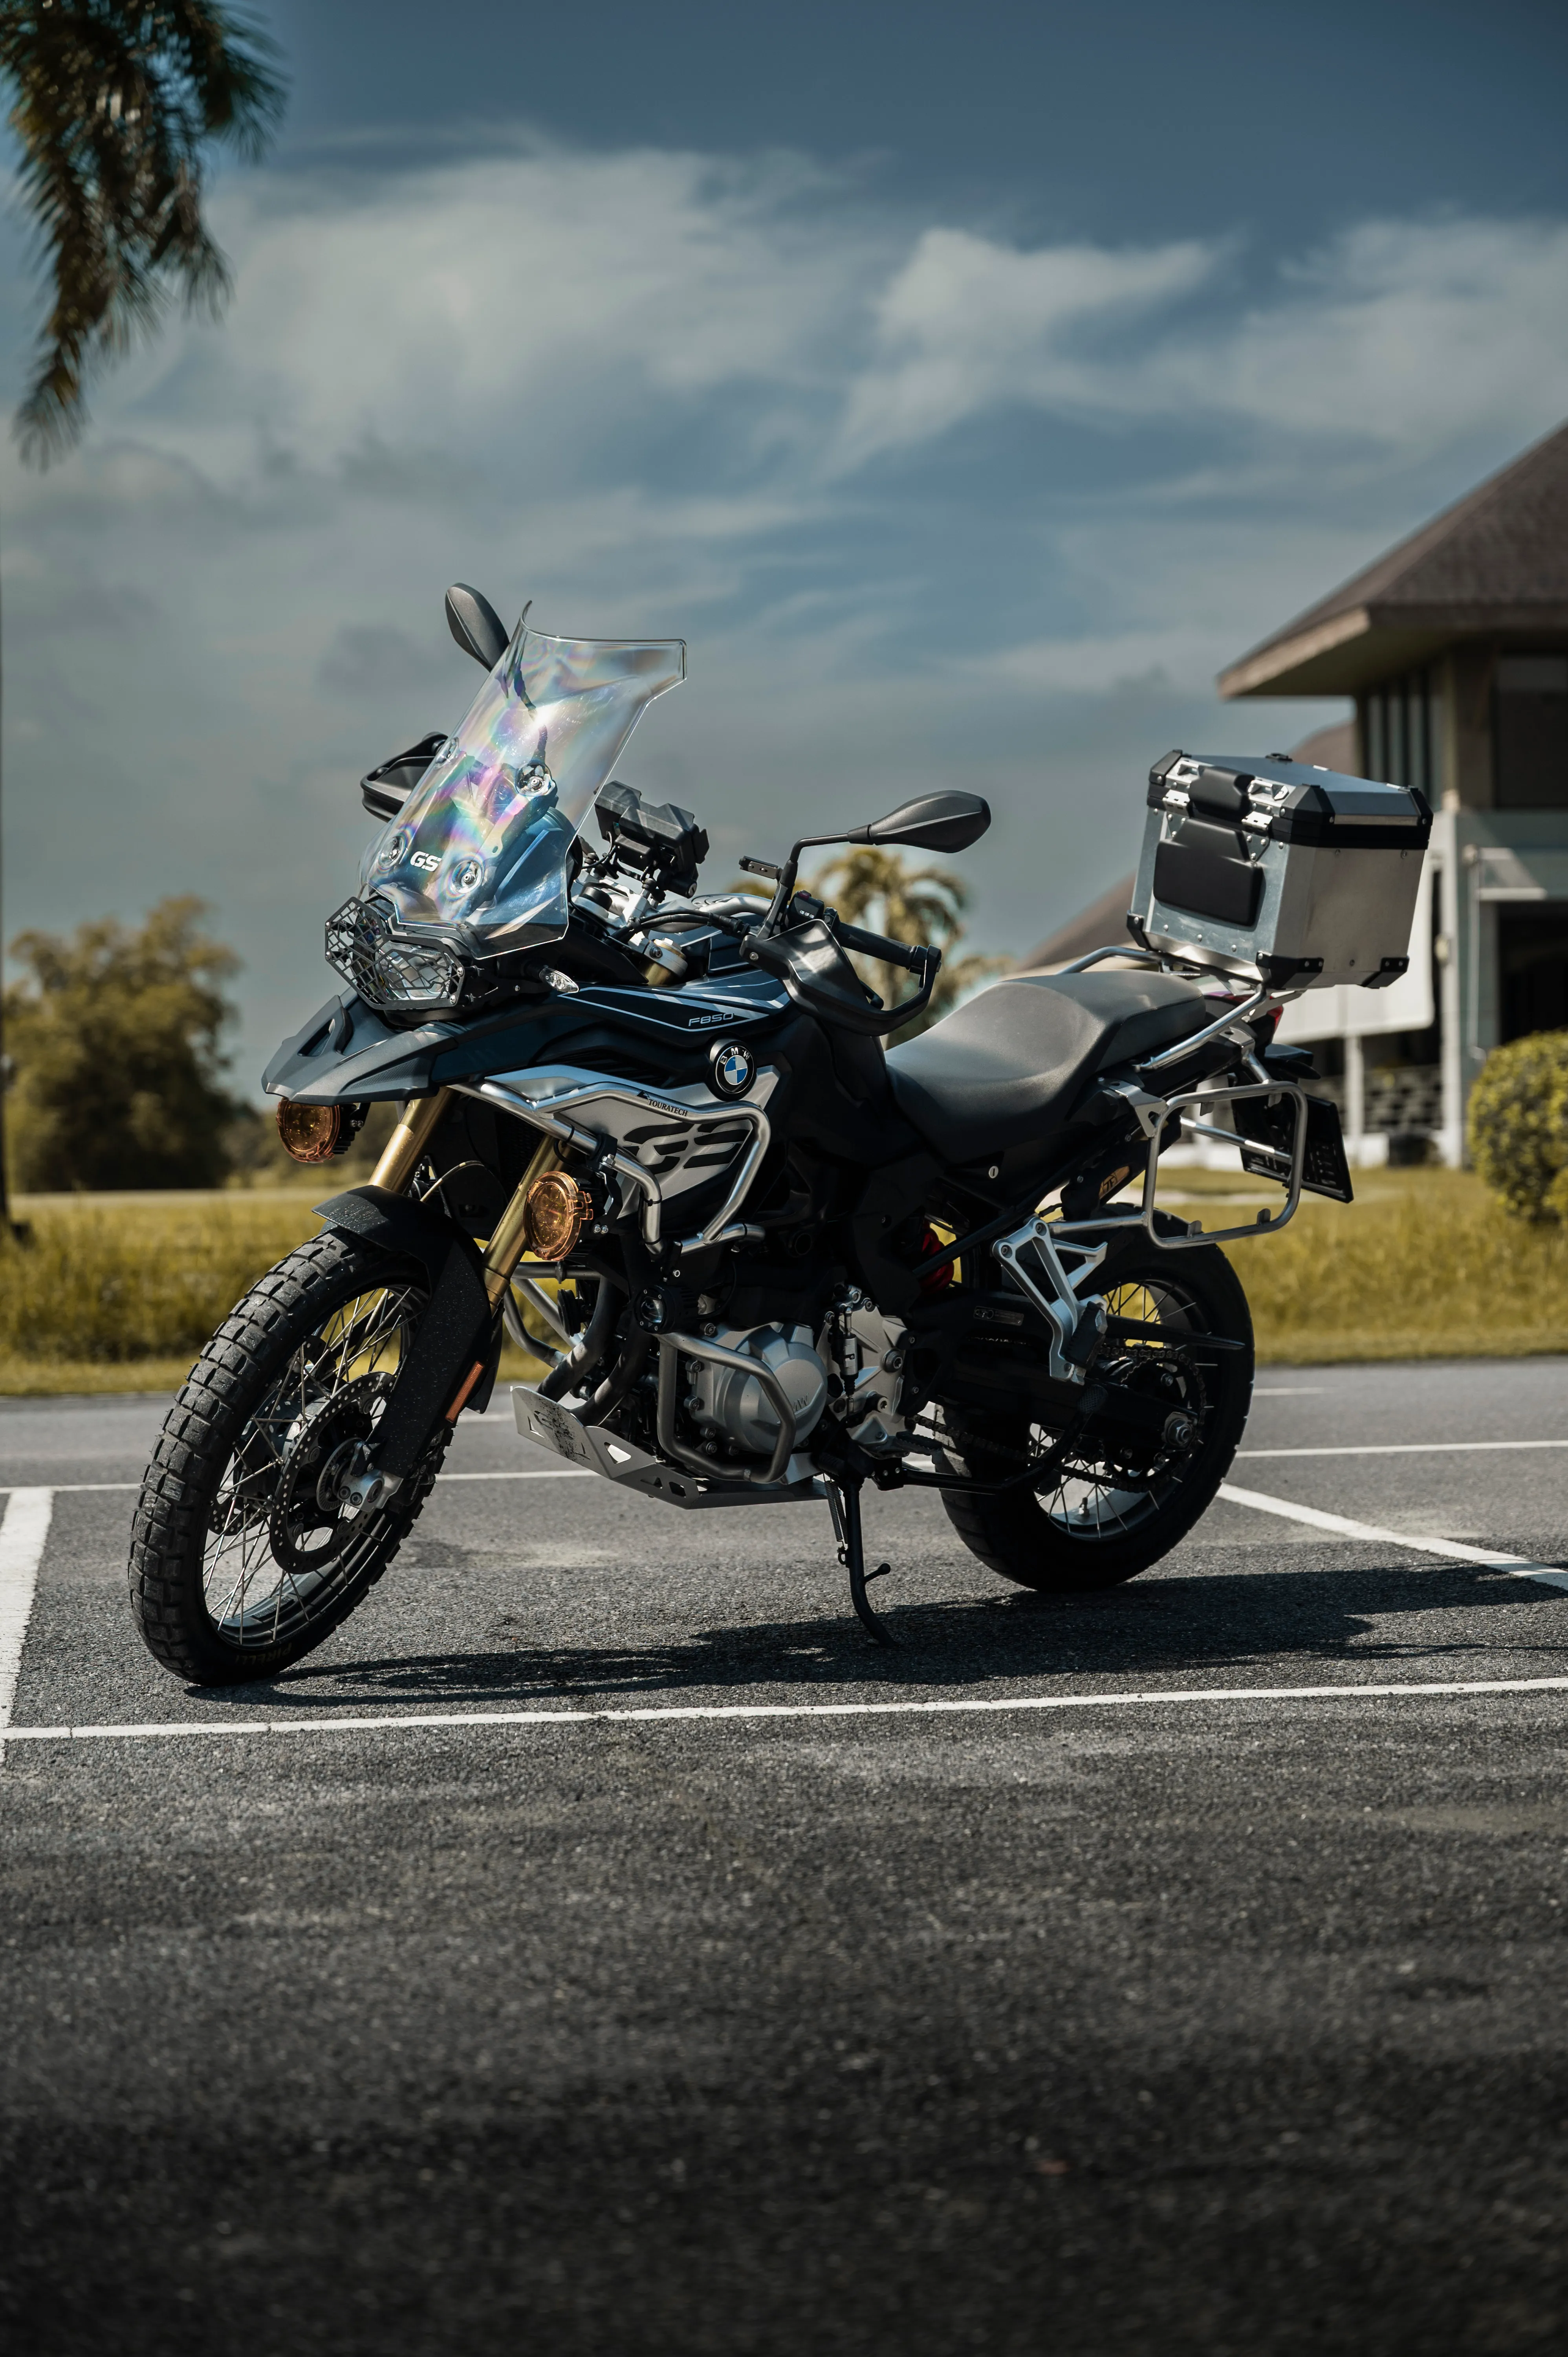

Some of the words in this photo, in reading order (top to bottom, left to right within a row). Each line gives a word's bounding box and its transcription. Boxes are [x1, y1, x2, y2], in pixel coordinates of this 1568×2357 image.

[410, 851, 442, 872] GS
[688, 1013, 734, 1026] F850
[720, 1047, 751, 1065] BMW
[648, 1099, 688, 1116] TOURATECH
[234, 1641, 292, 1666] PIRELLI
